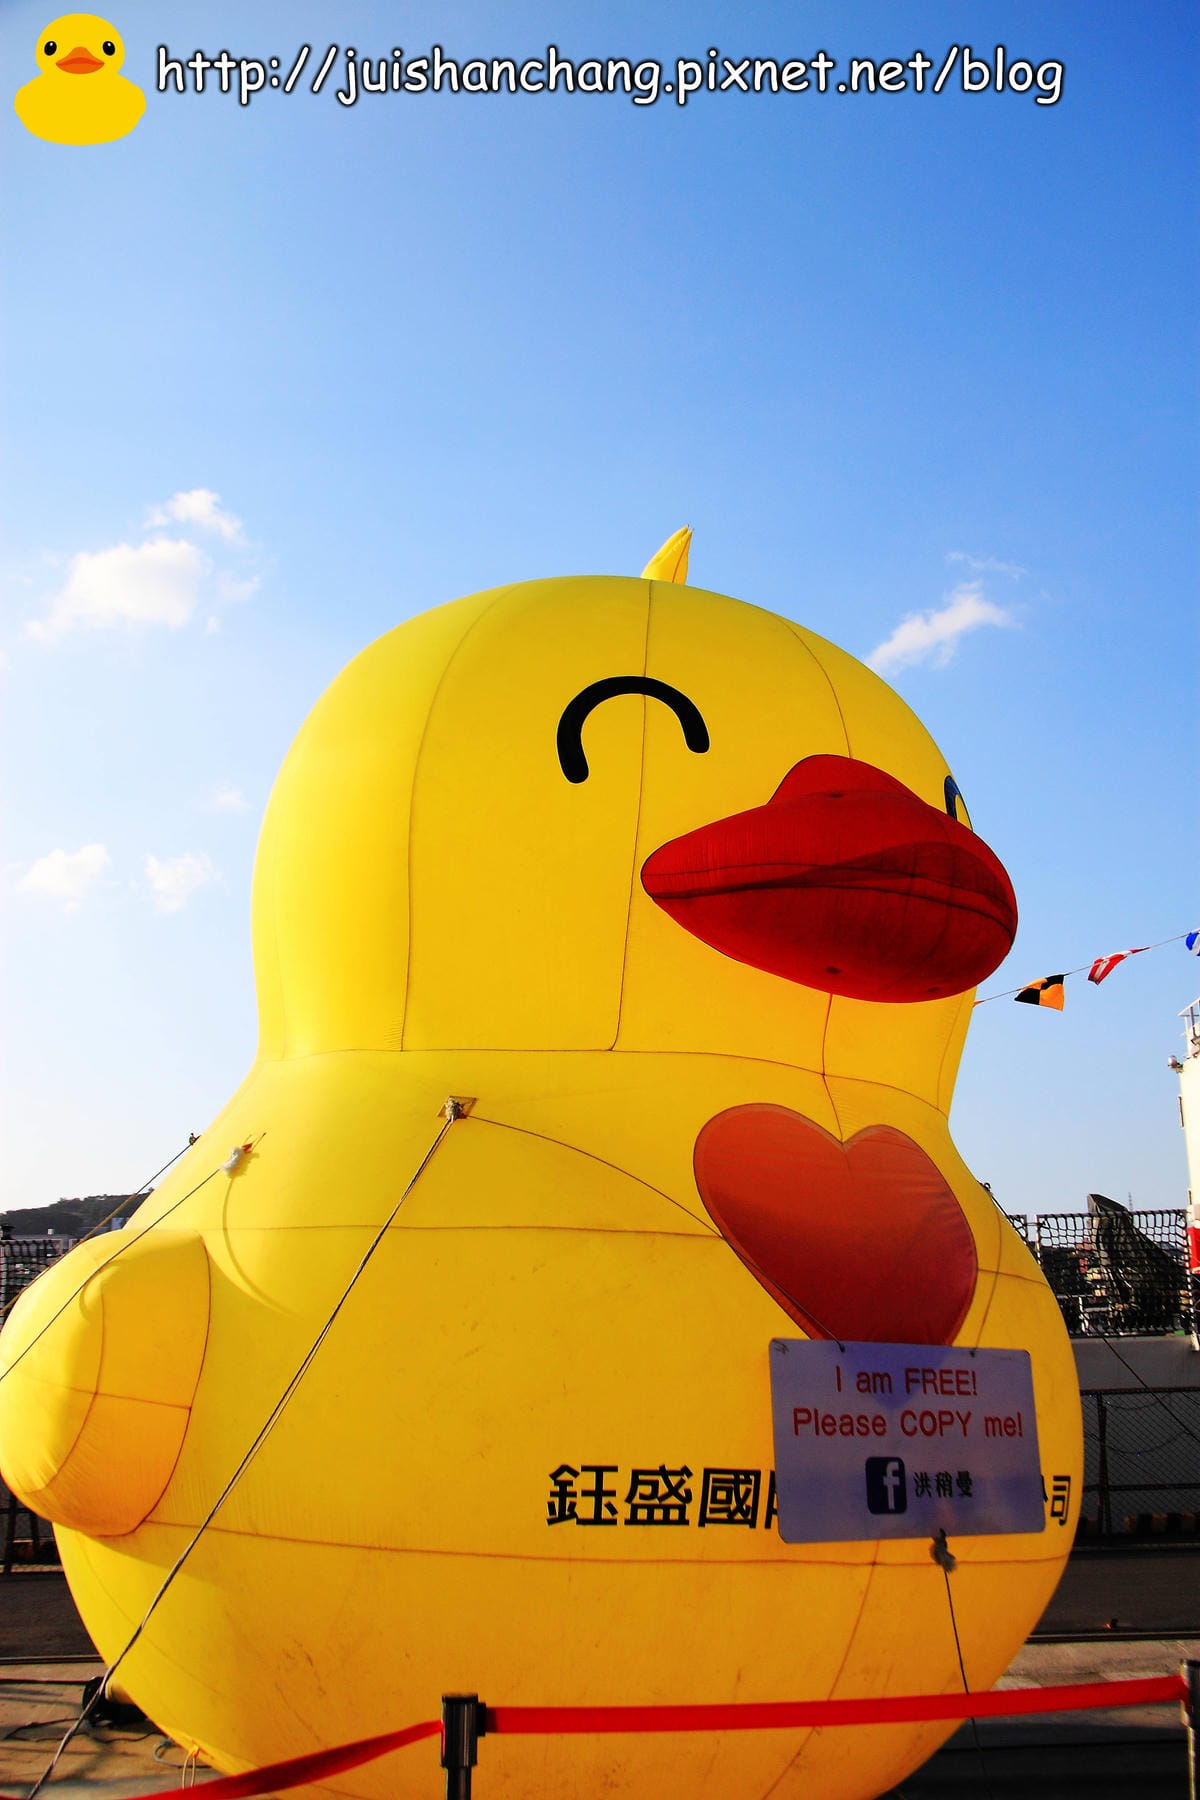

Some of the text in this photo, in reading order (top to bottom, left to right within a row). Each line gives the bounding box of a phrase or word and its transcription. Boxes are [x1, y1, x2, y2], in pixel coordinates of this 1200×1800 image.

[835, 1365, 978, 1396] I am FREE!
[793, 1408, 1024, 1438] Please COPY me!
